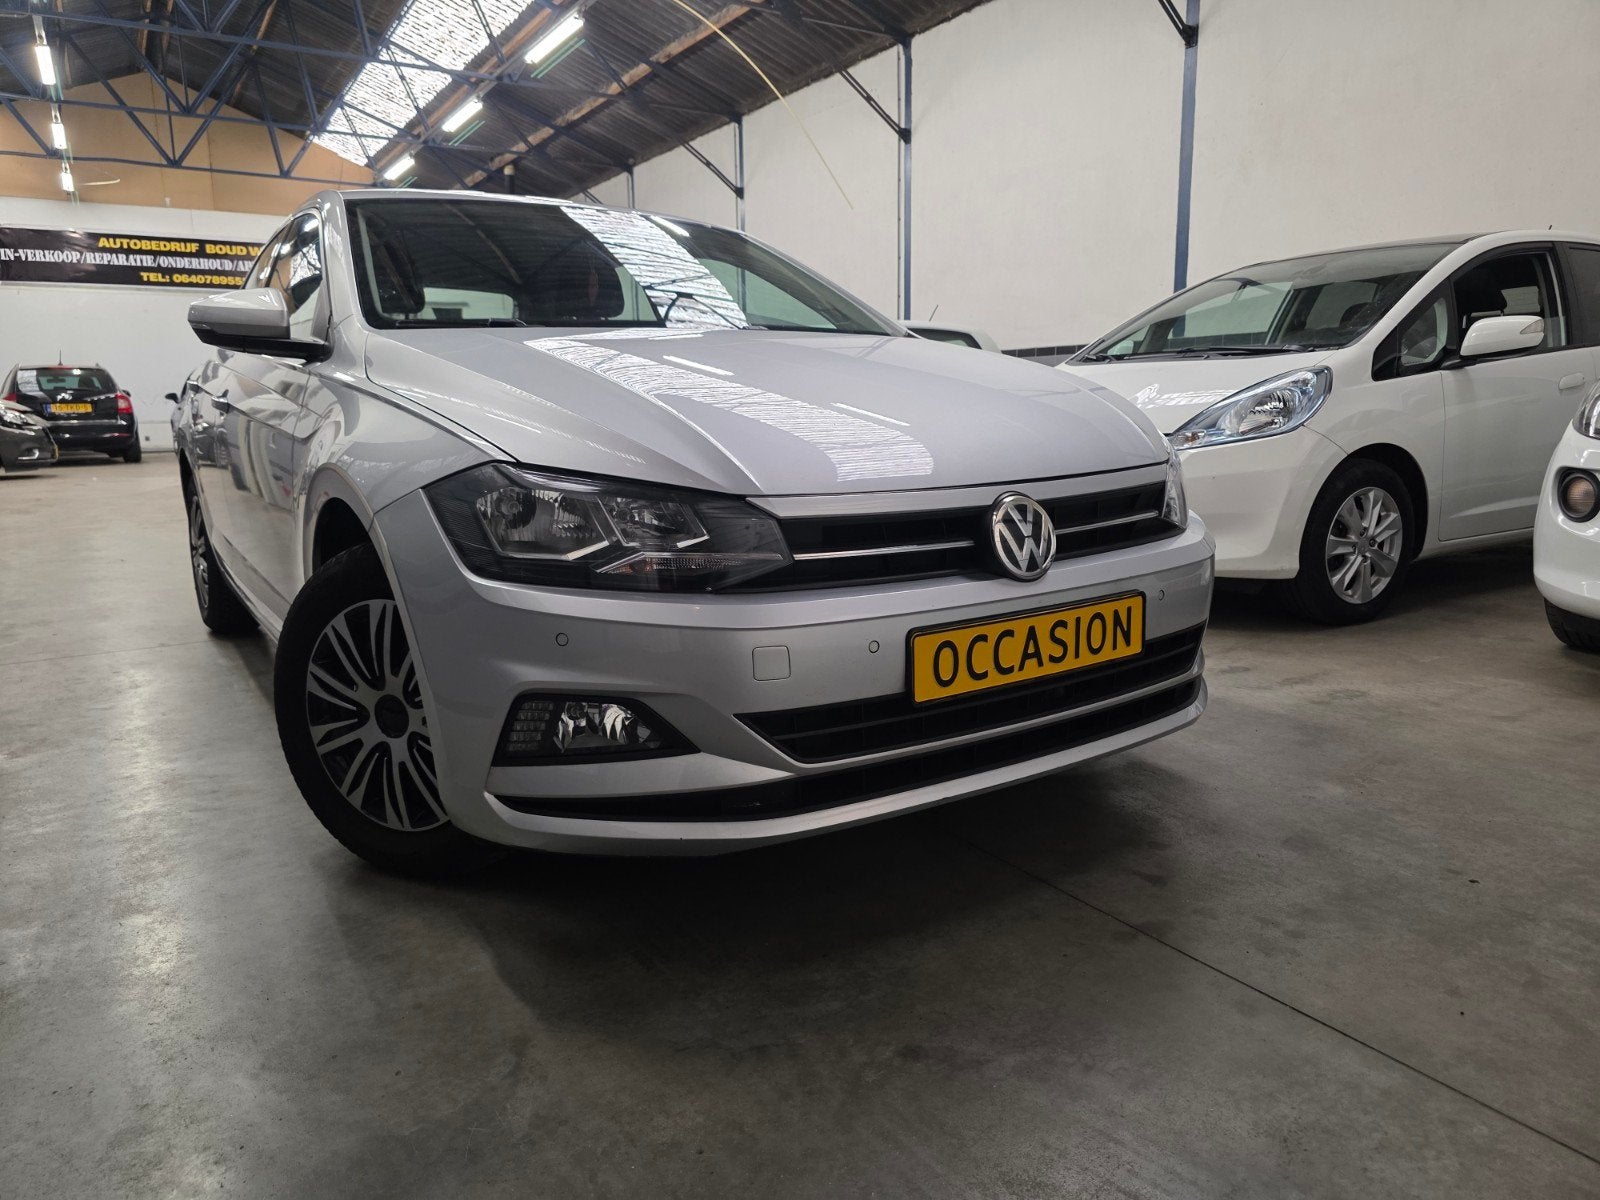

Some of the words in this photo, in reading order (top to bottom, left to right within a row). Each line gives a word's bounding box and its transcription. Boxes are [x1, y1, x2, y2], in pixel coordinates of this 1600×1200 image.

[98, 237, 199, 253] AUTOBEDRIJF
[205, 244, 247, 256] BOUD
[140, 272, 170, 283] TEL:
[173, 274, 245, 286] 064078955
[933, 606, 1132, 688] OCCASION
